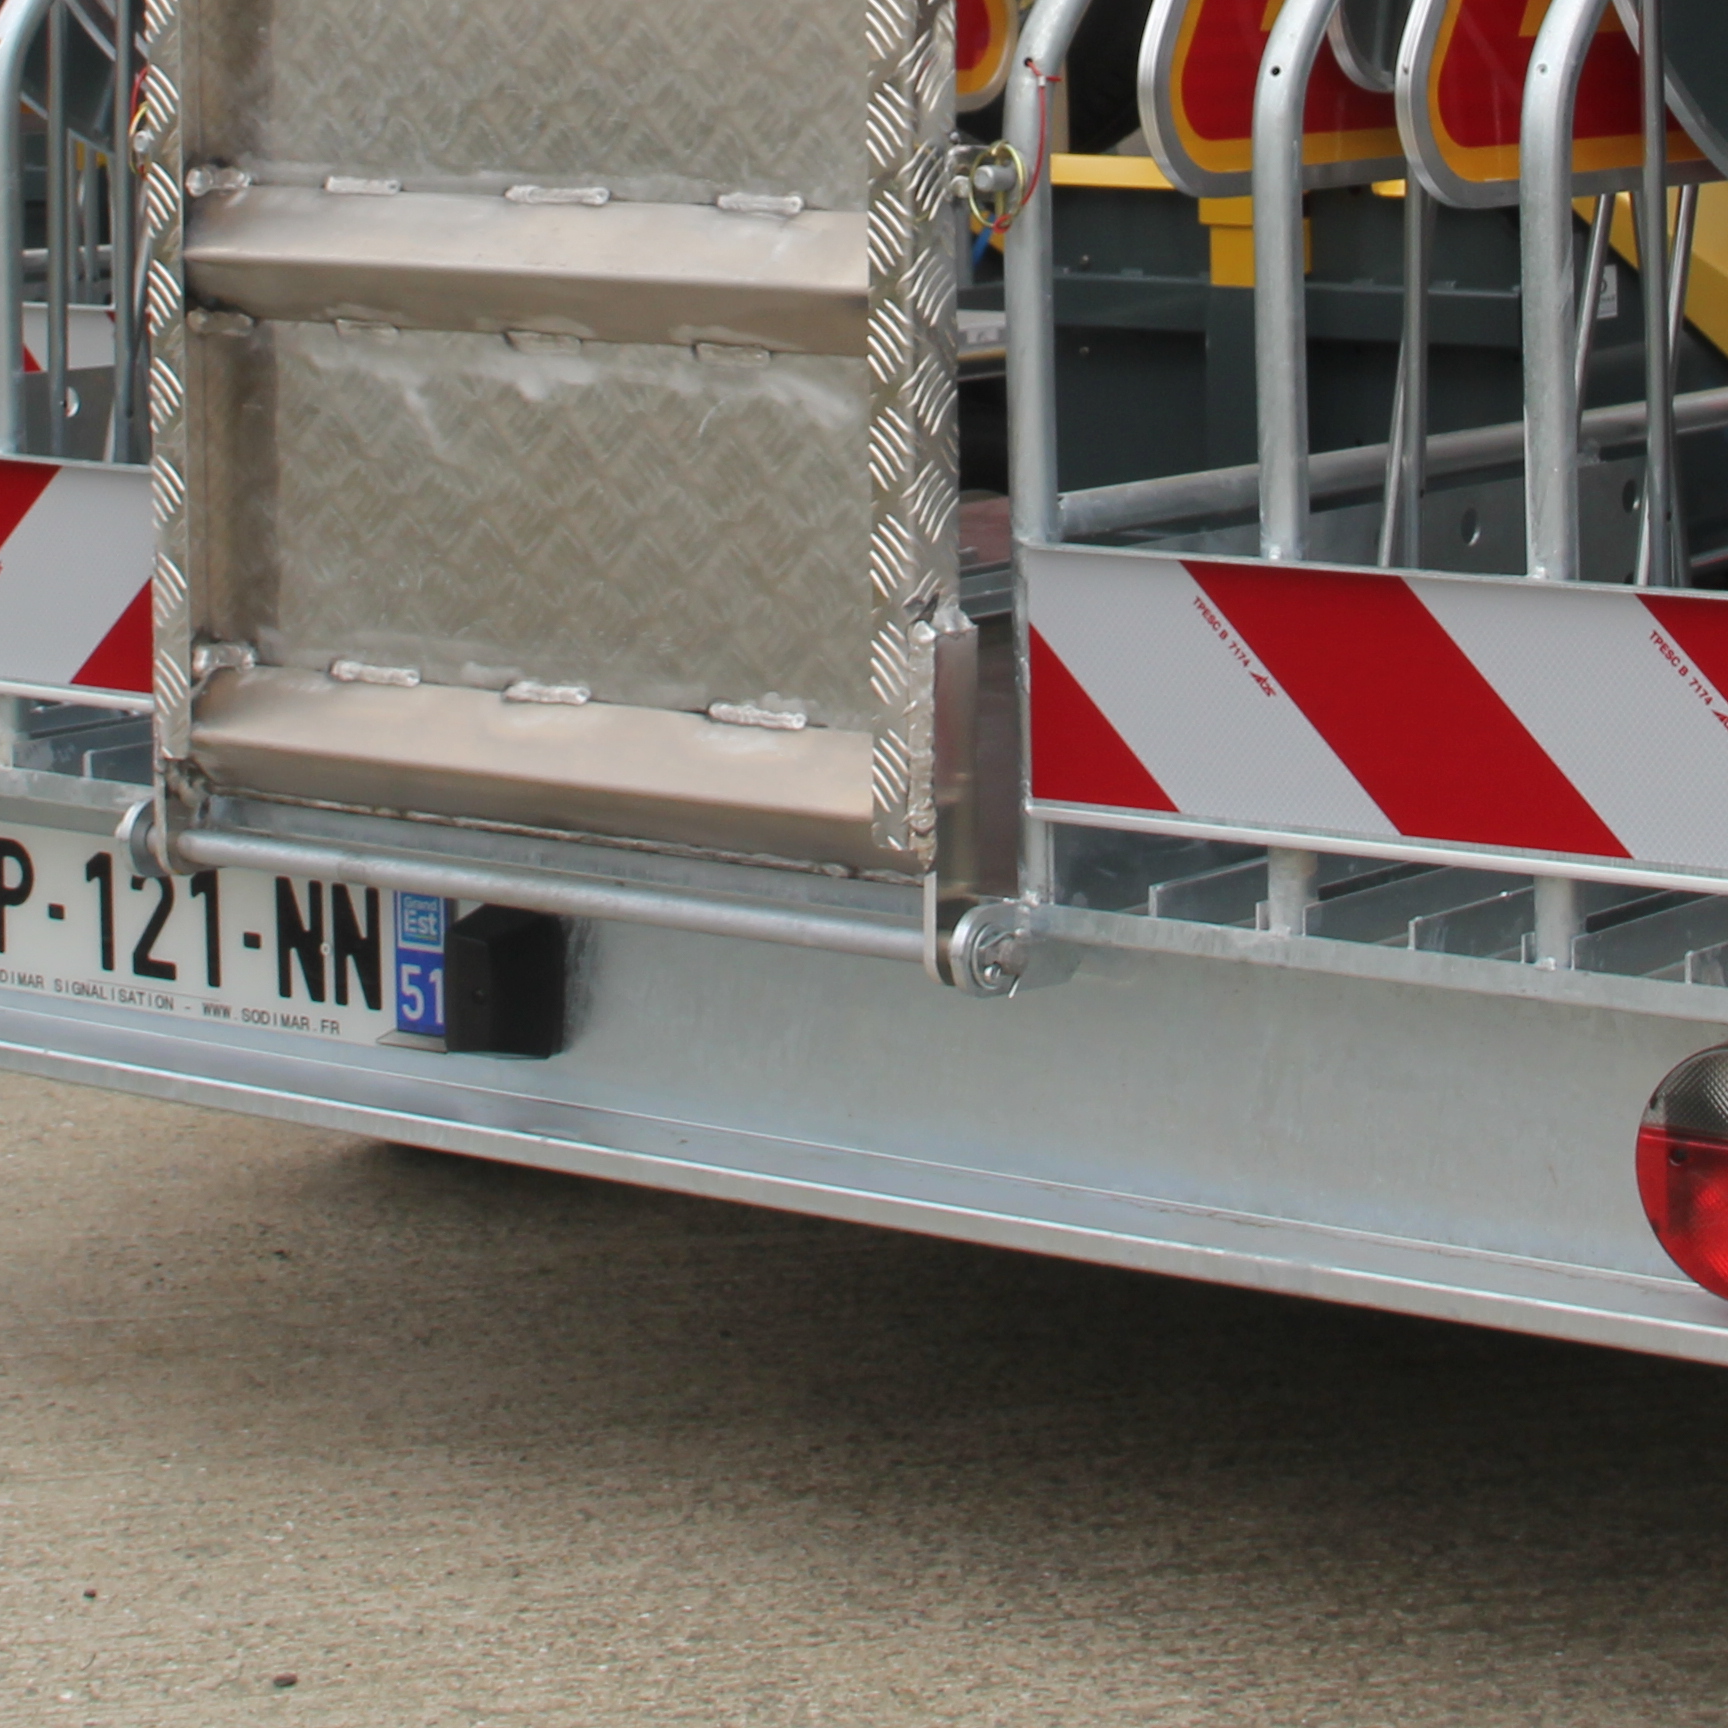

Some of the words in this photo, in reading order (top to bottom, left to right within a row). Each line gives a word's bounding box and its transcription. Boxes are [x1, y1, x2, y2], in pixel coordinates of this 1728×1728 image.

[1193, 595, 1222, 631] TPESC
[1219, 629, 1229, 640] B
[1228, 640, 1251, 668] 7174
[1649, 629, 1681, 667] TPESC
[1678, 665, 1689, 677] B
[1689, 676, 1714, 706] 7174
[403, 895, 440, 914] Grand
[403, 910, 439, 939] Est
[53, 977, 175, 1011] SIGNALISATION
[401, 964, 445, 1022] 51
